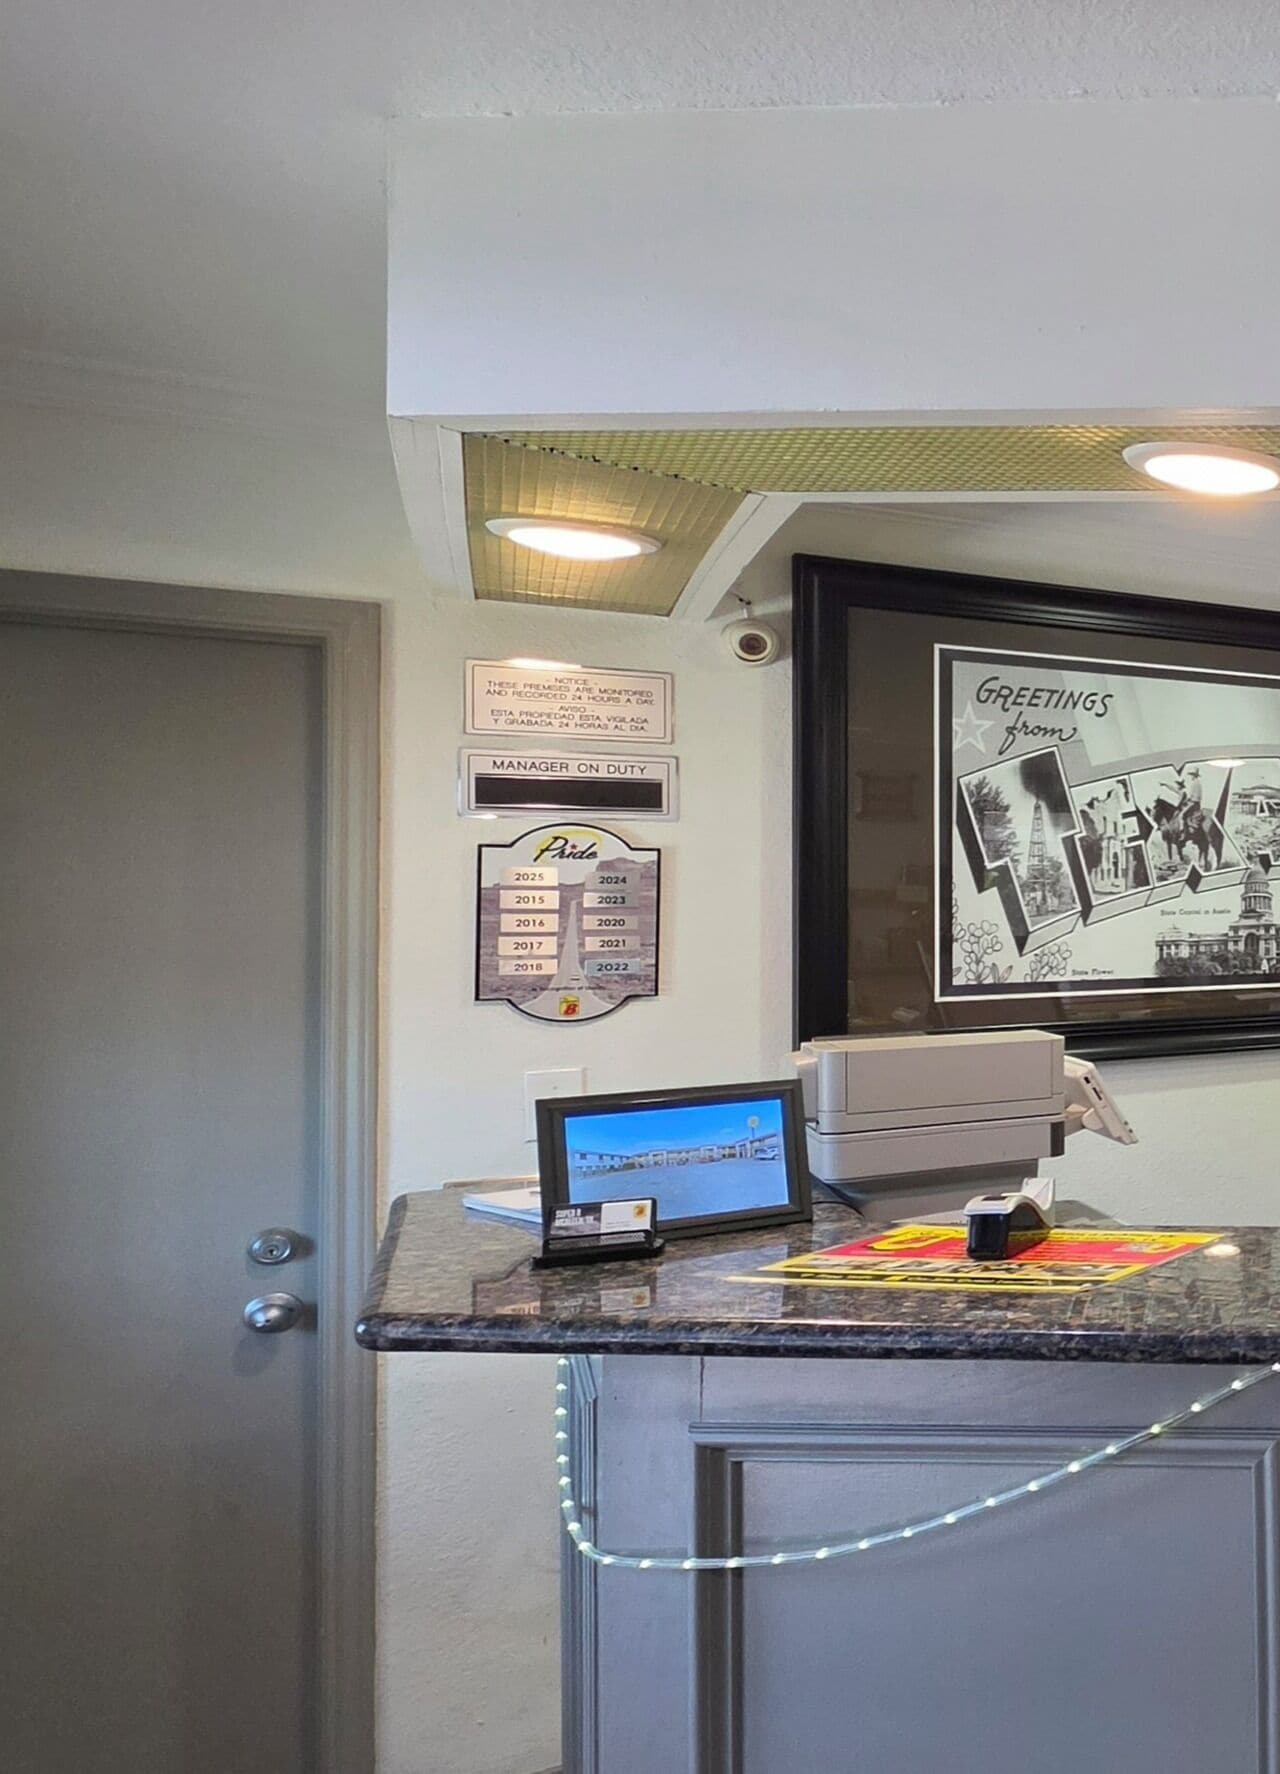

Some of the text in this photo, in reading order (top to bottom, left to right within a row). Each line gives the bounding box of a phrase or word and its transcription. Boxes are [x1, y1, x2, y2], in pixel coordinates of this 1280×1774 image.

[554, 677, 588, 686] NOTICE
[487, 680, 653, 697] THESE PREMISES ARE MONITORED
[512, 690, 567, 700] RECORDED
[587, 695, 621, 704] HOURS
[975, 676, 1115, 718] GREETINGS
[558, 705, 586, 713] AVISO
[490, 709, 649, 724] ESTA PROPIEDAD ESTA VIGILADA
[504, 718, 553, 727] GRABADA
[574, 722, 608, 730] HORAS
[613, 723, 625, 731] AL
[997, 711, 1078, 756] from
[492, 759, 647, 775] MANAGER ON DUTY
[533, 835, 599, 862] Pride
[514, 873, 544, 881] 2025
[599, 876, 627, 884] 2024
[515, 896, 545, 904] 2015
[597, 896, 626, 904] 2023
[516, 919, 545, 927] 2016
[513, 942, 543, 950] 2017
[599, 939, 626, 948] 2021
[597, 963, 629, 971] 2022
